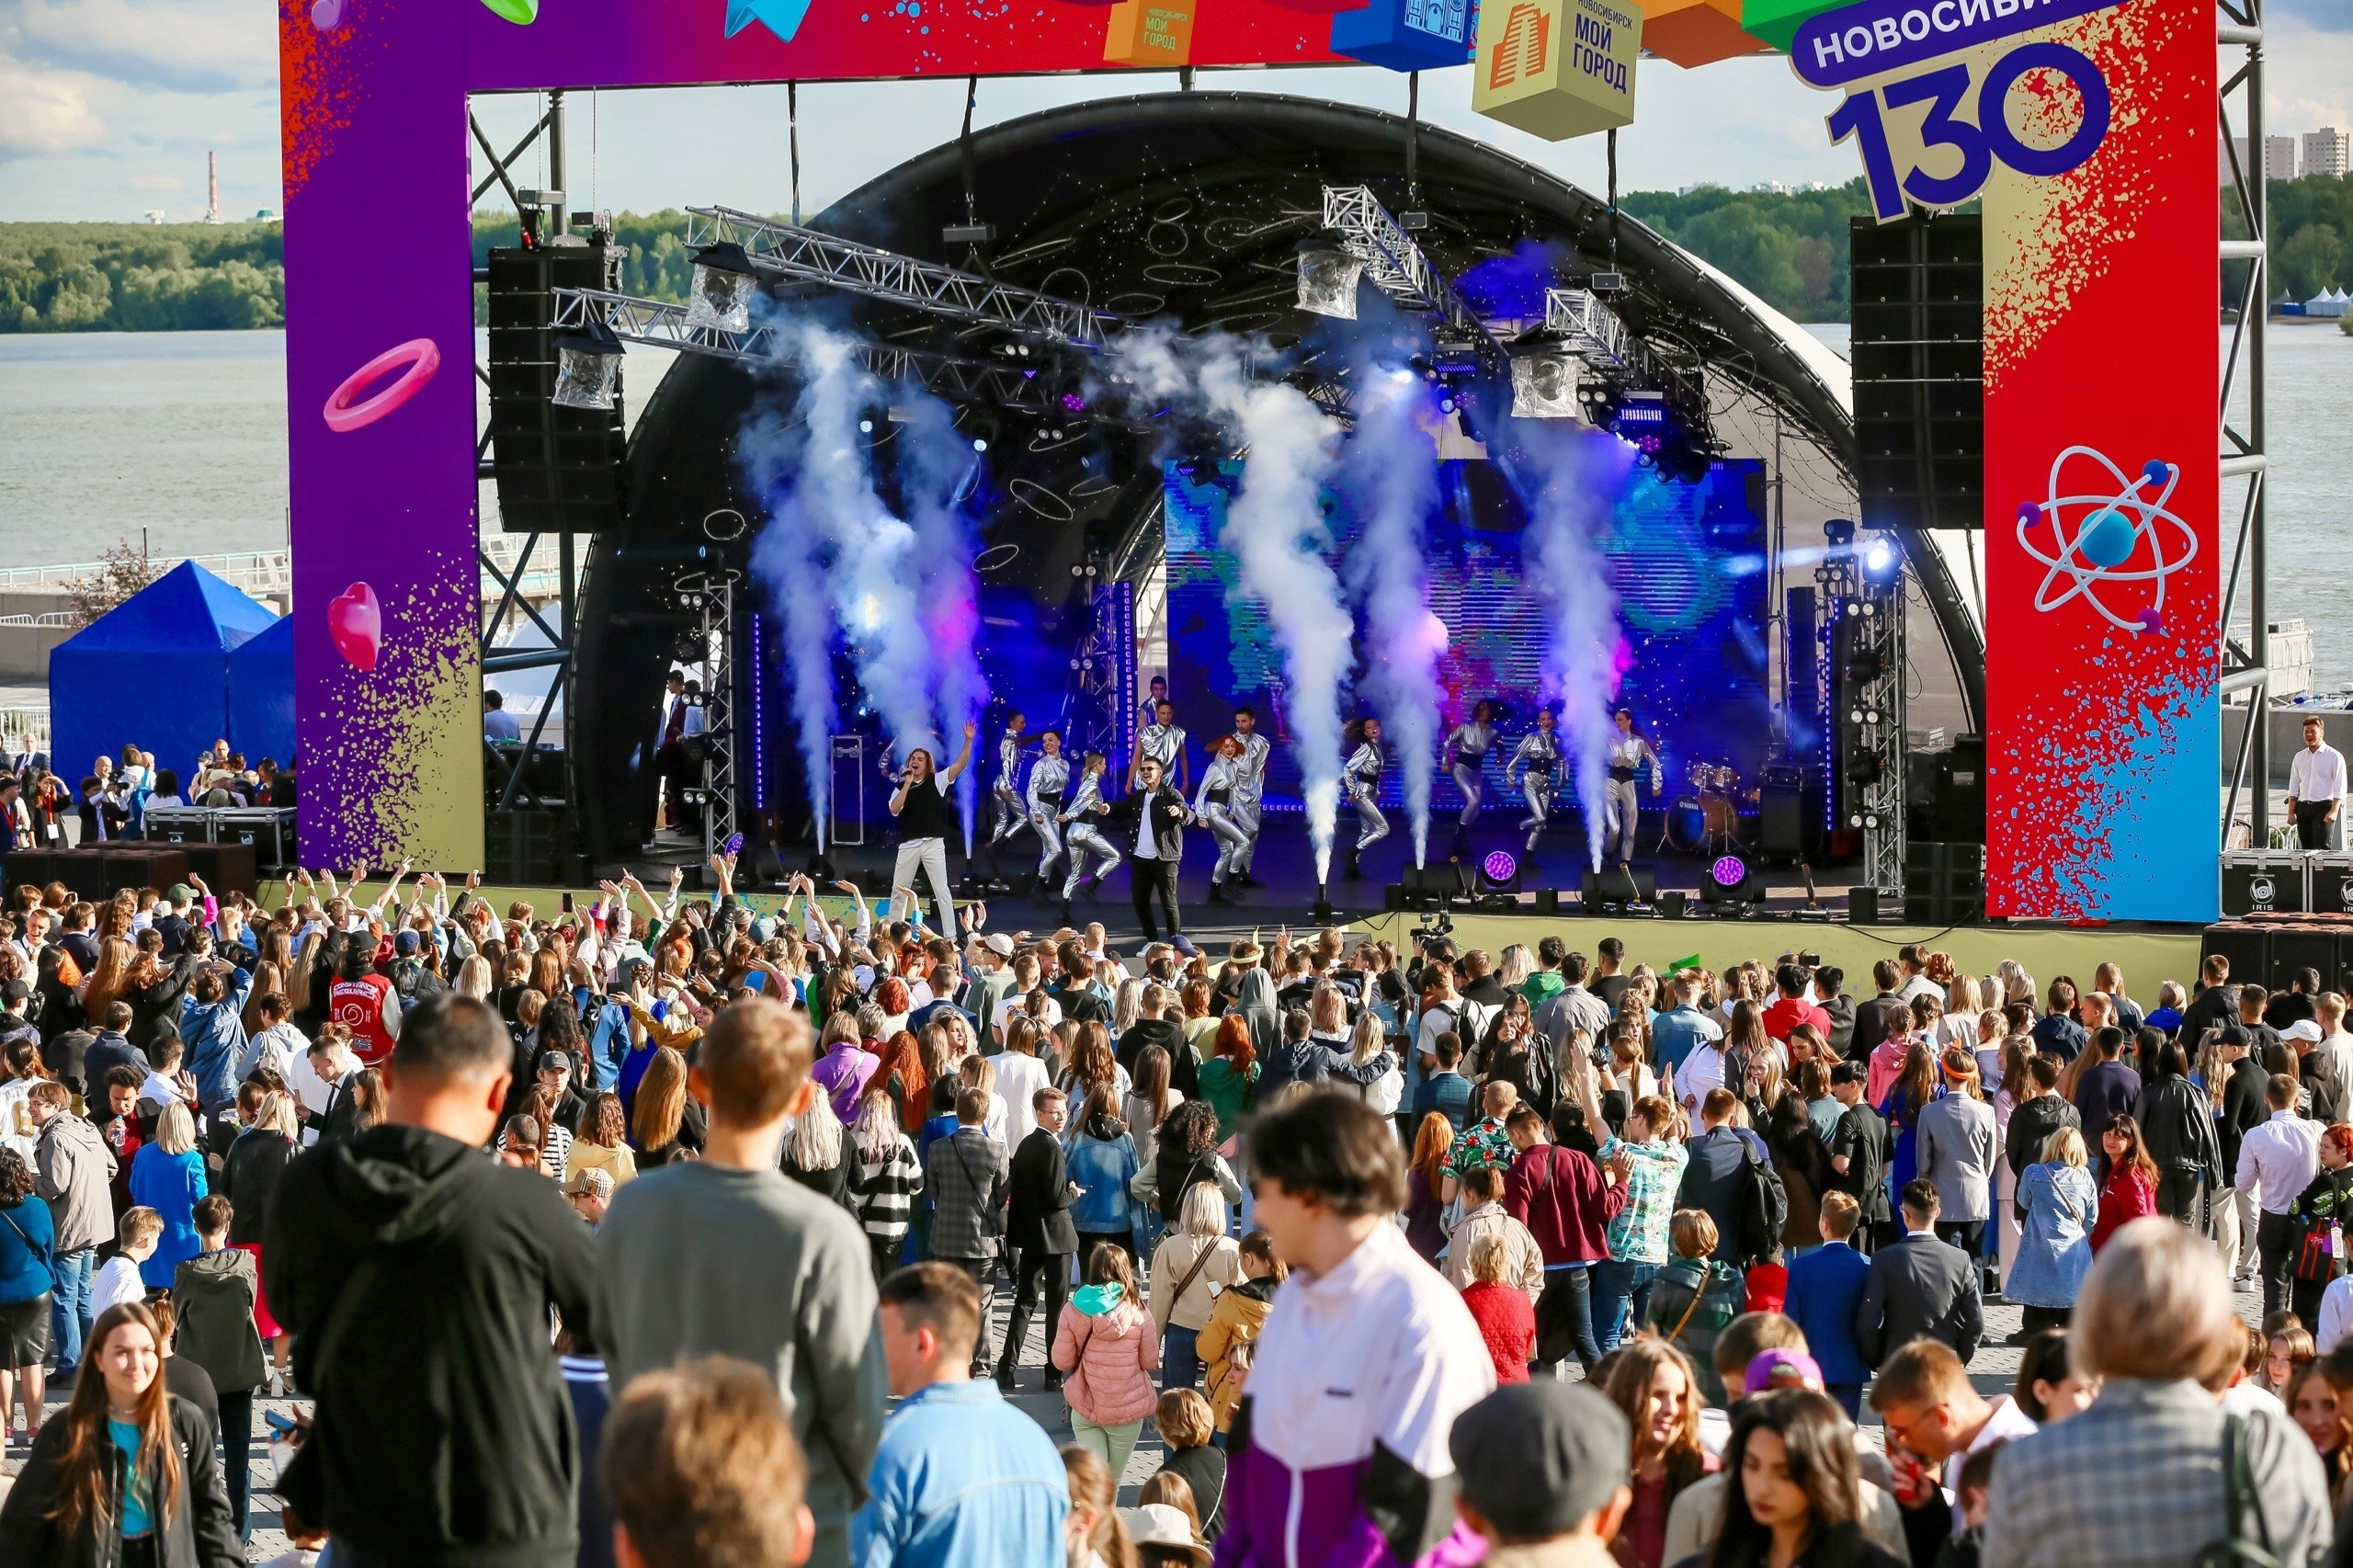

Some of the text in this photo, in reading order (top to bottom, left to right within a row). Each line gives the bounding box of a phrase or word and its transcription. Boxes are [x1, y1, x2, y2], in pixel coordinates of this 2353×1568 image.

[1143, 31, 1176, 51] ГОРОД
[1574, 13, 1612, 53] МОЙ
[1813, 0, 2060, 69] НОВОСИБ
[1573, 42, 1627, 95] ГОРОД
[1827, 42, 2111, 221] 130
